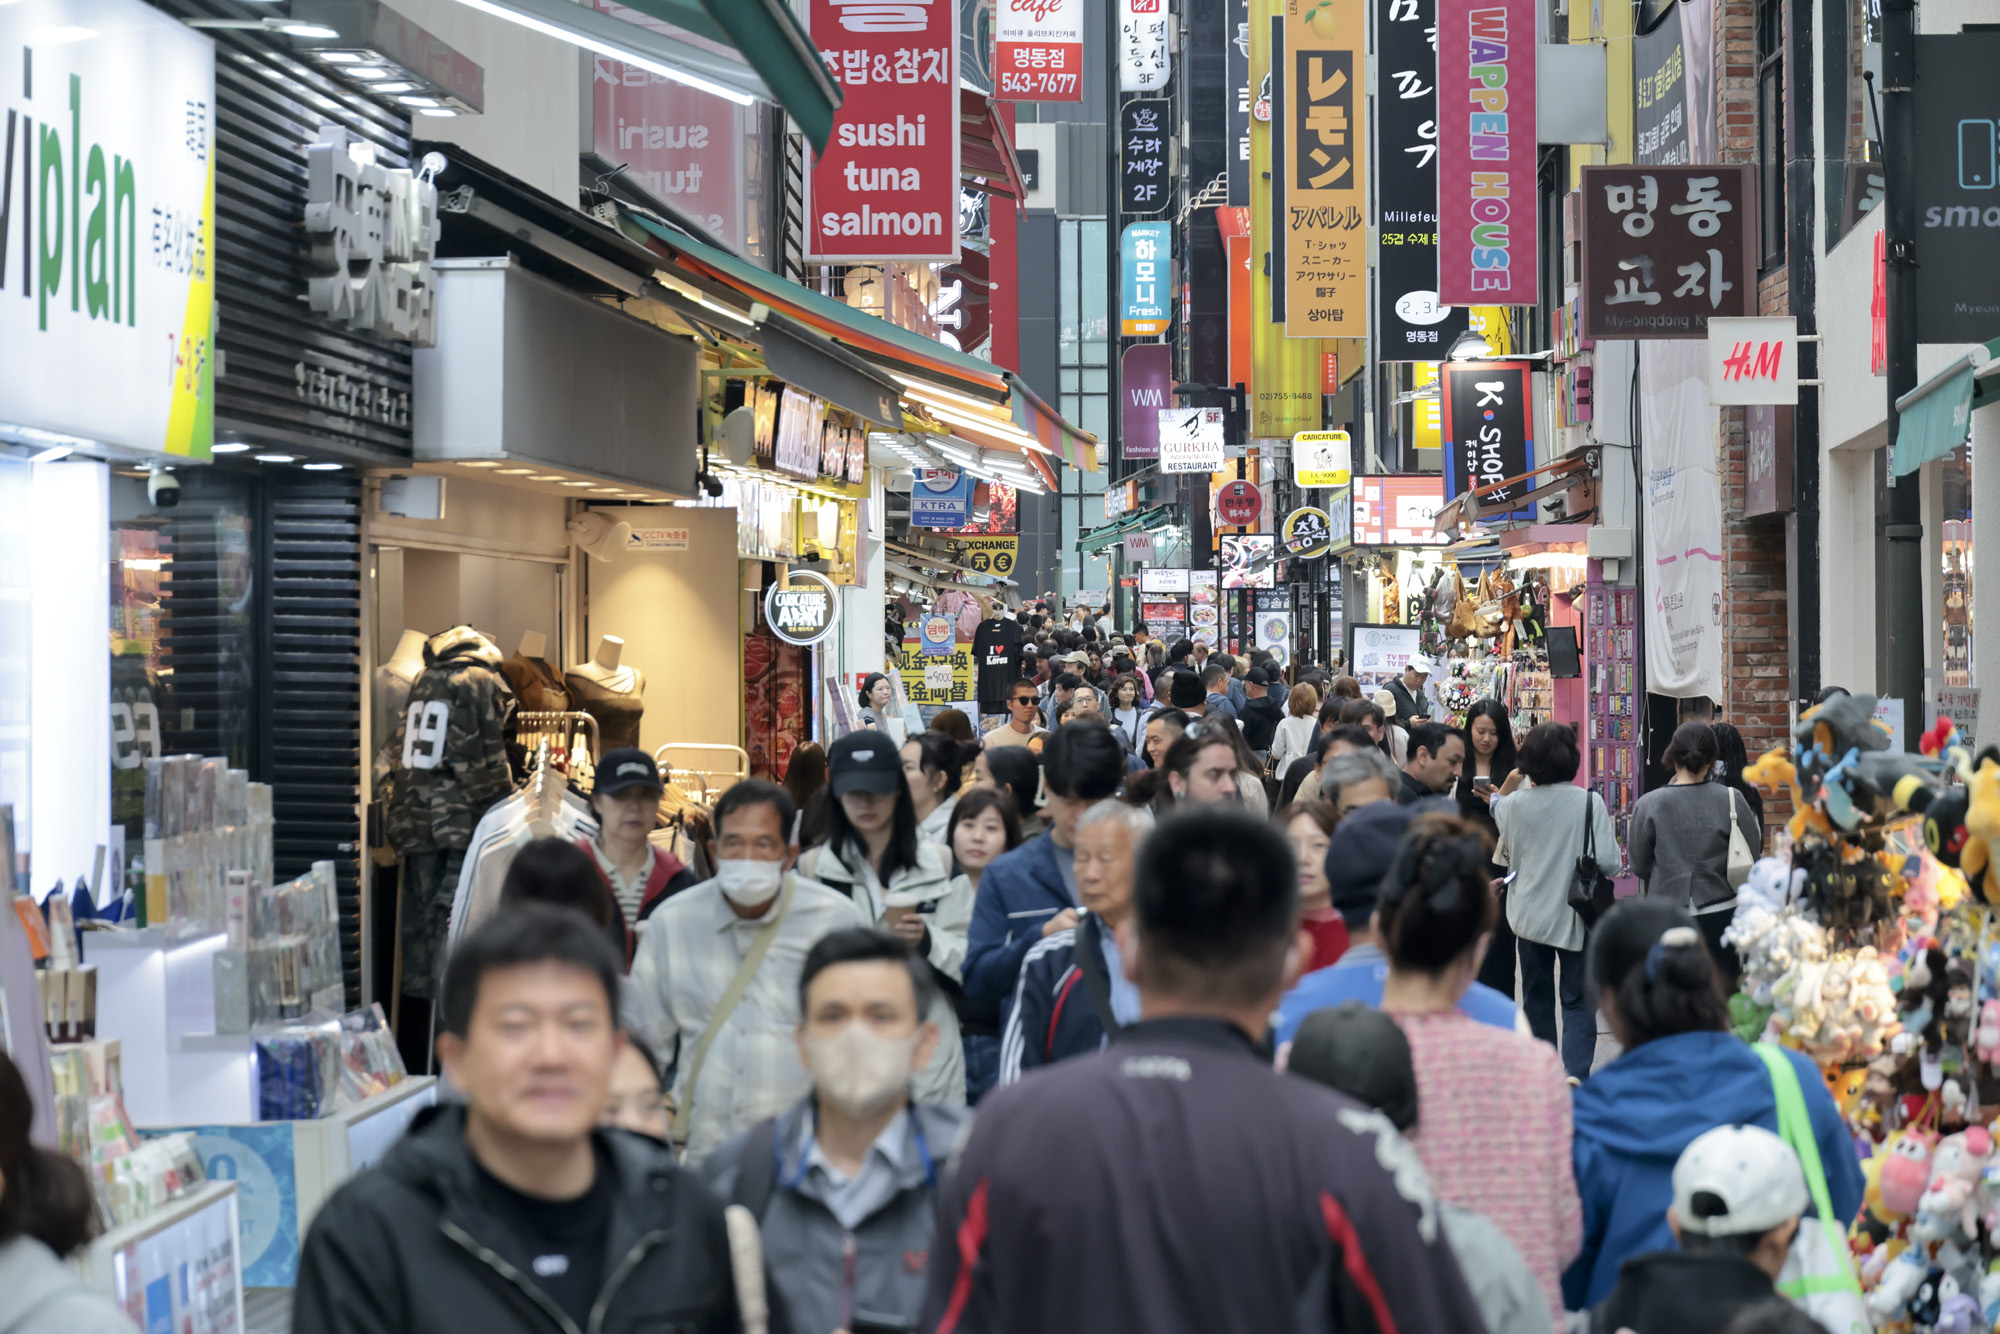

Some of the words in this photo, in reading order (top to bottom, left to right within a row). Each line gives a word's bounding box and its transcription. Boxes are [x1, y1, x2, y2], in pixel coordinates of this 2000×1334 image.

[1013, 48, 1065, 68] 명동점
[1002, 72, 1077, 93] 543-7677
[1138, 73, 1154, 84] 3F
[1469, 7, 1509, 161] WAPPEN
[838, 114, 926, 146] sushi
[1305, 57, 1351, 189] レモン
[1128, 136, 1162, 155] 수라
[844, 161, 920, 191] tuna
[1134, 185, 1157, 201] 2F
[1603, 175, 1733, 237] 명동
[822, 204, 942, 236] salmon
[1290, 205, 1362, 231] アパレル
[1471, 172, 1510, 291] HOUSE
[1382, 233, 1404, 245] 25겹
[1407, 233, 1429, 245] 수제
[1301, 256, 1351, 265] スニーカー
[1135, 239, 1156, 304] 하모니
[1604, 249, 1733, 310] 교자
[1315, 287, 1336, 298] 帽子
[1129, 306, 1162, 316] Fresh
[1307, 308, 1344, 321] 상아탑
[1605, 314, 1690, 328] Myeongdong
[1406, 331, 1438, 343] 명동점
[1723, 340, 1783, 381] H&M
[1131, 389, 1163, 406] WM
[1206, 413, 1220, 422] 5F
[1164, 442, 1220, 453] GURKHA
[1168, 462, 1217, 470] RESTAURANT
[921, 502, 956, 510] KTRA
[644, 531, 665, 539] CCTV
[1130, 538, 1149, 548] WM
[775, 593, 826, 607] CARICATURE
[927, 624, 948, 636] 담배
[986, 655, 1008, 666] Korea
[1957, 693, 1979, 708] 기념품
